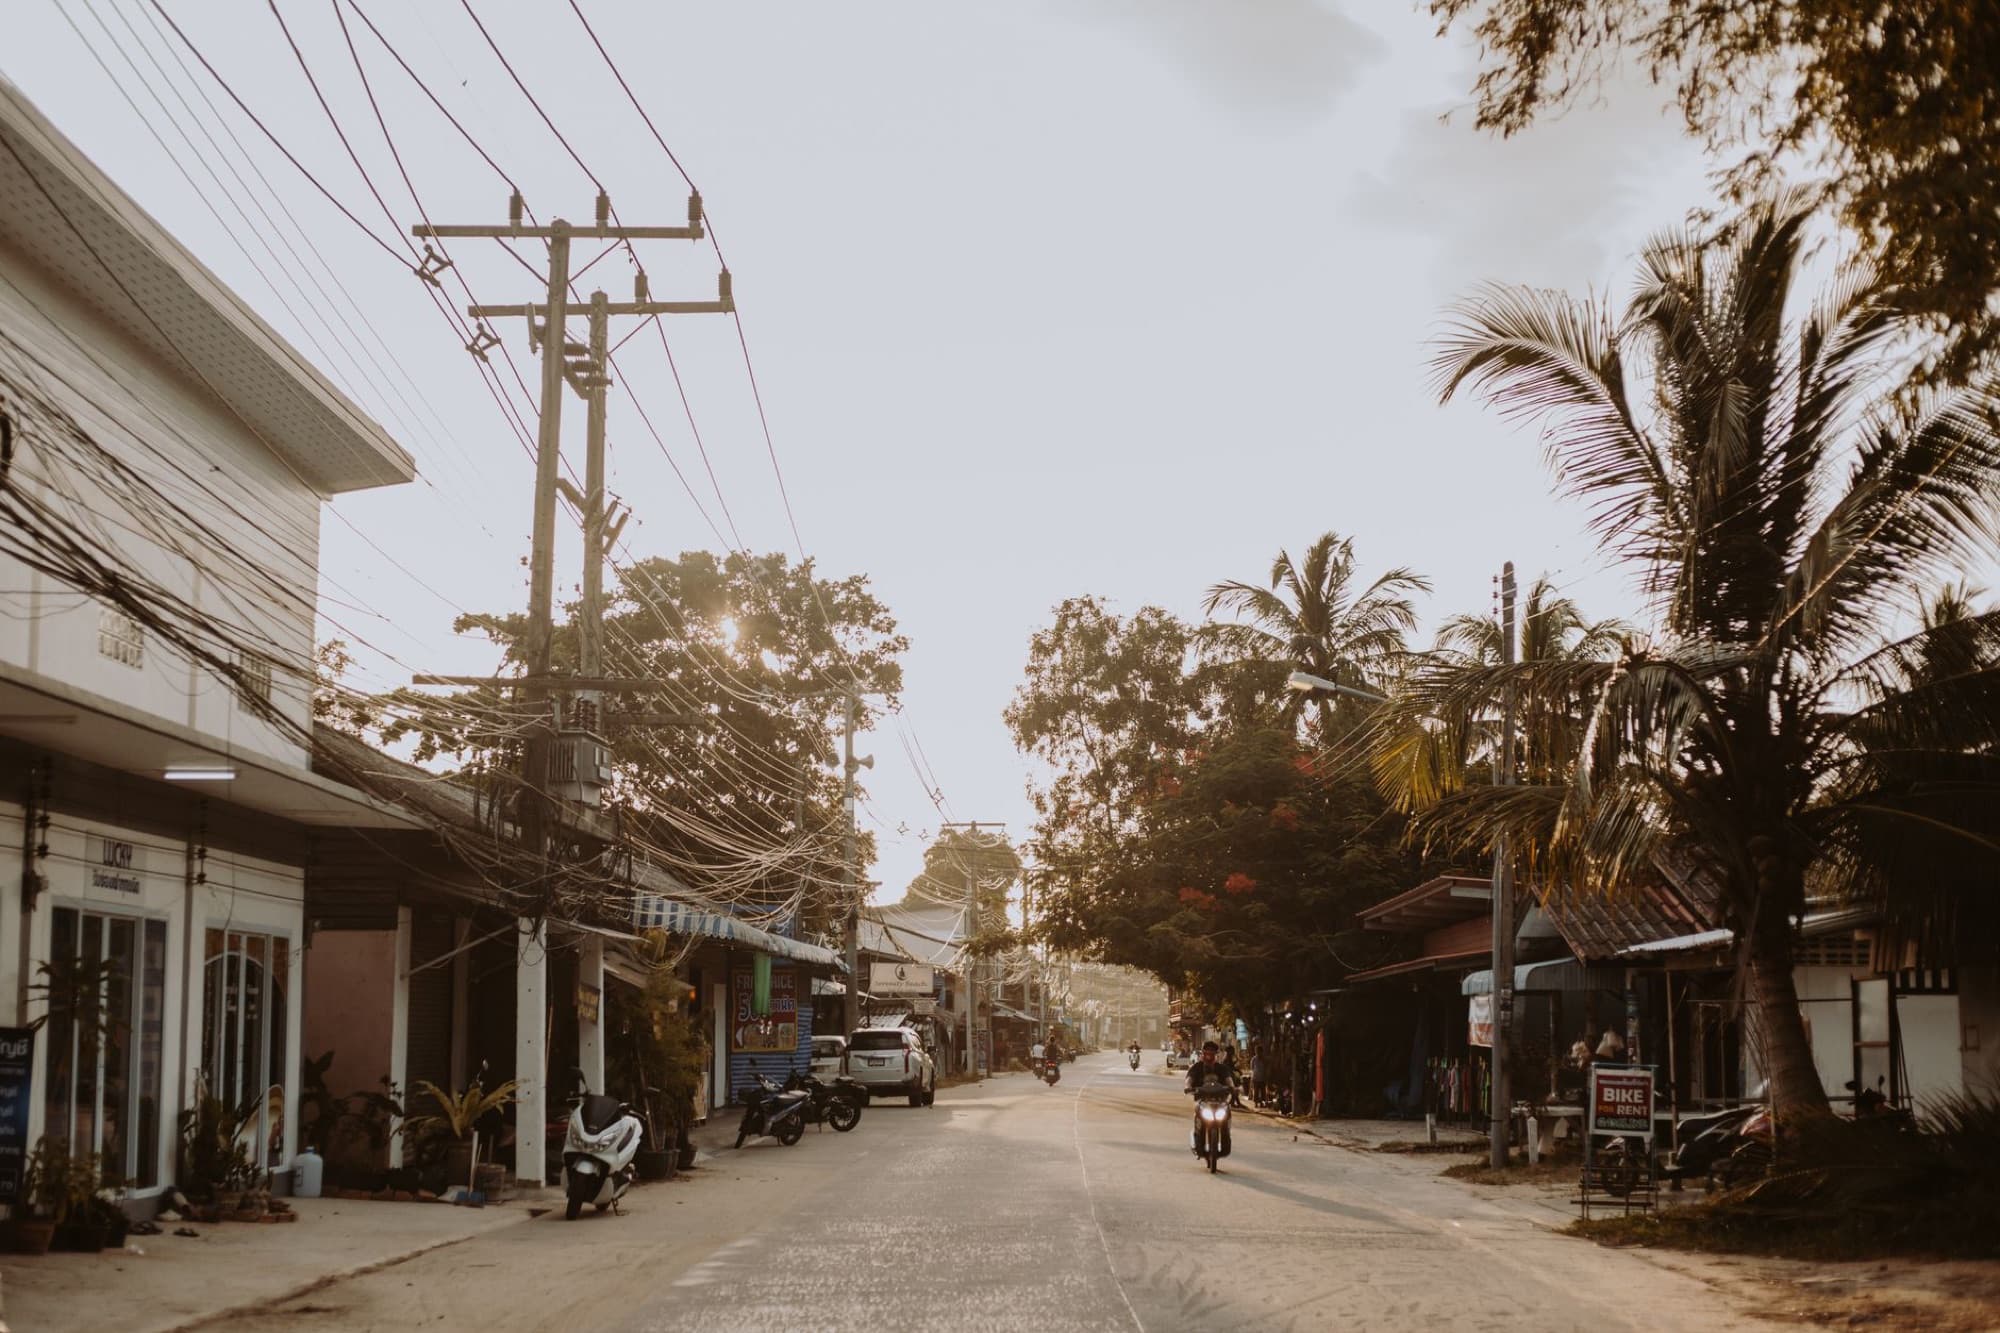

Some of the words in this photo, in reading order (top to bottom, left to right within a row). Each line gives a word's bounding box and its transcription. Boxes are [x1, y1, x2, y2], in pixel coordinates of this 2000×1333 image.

[103, 839, 133, 869] LUCKY
[1603, 1087, 1644, 1103] BIKE
[1616, 1104, 1648, 1116] RENT
